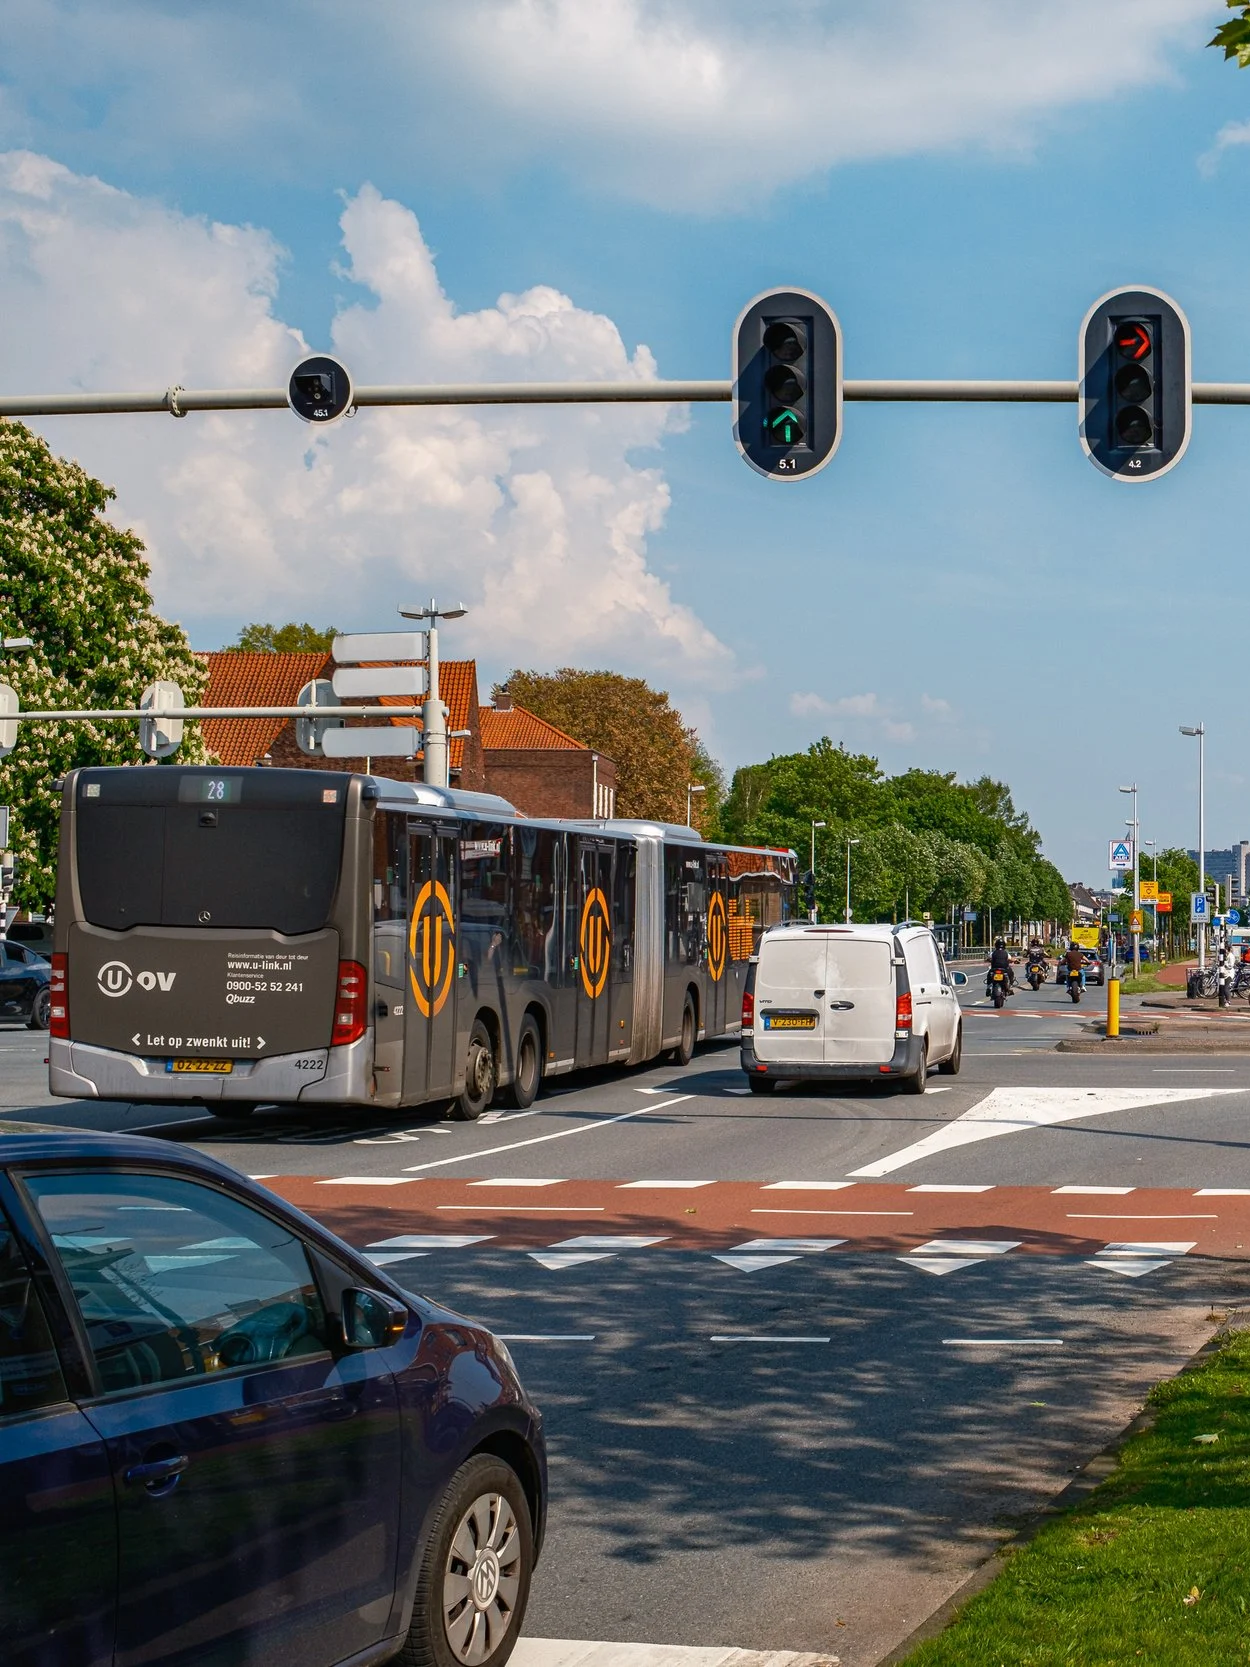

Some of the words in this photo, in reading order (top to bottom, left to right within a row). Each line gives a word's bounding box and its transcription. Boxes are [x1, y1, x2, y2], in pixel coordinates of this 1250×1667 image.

[779, 458, 796, 469] 5.1
[1128, 459, 1142, 468] 4.2
[207, 780, 225, 799] 28
[227, 952, 265, 960] Reisinformatie
[227, 960, 292, 970] www.u-link.nl
[226, 980, 268, 992] 0900-52
[270, 982, 283, 992] 52
[285, 982, 304, 993] 241
[225, 993, 256, 1005] Qbuzz
[147, 1034, 165, 1046] Let
[168, 1036, 182, 1048] op
[186, 1036, 228, 1048] zwenkt
[231, 1036, 251, 1048] uit!
[294, 1059, 324, 1070] 4222
